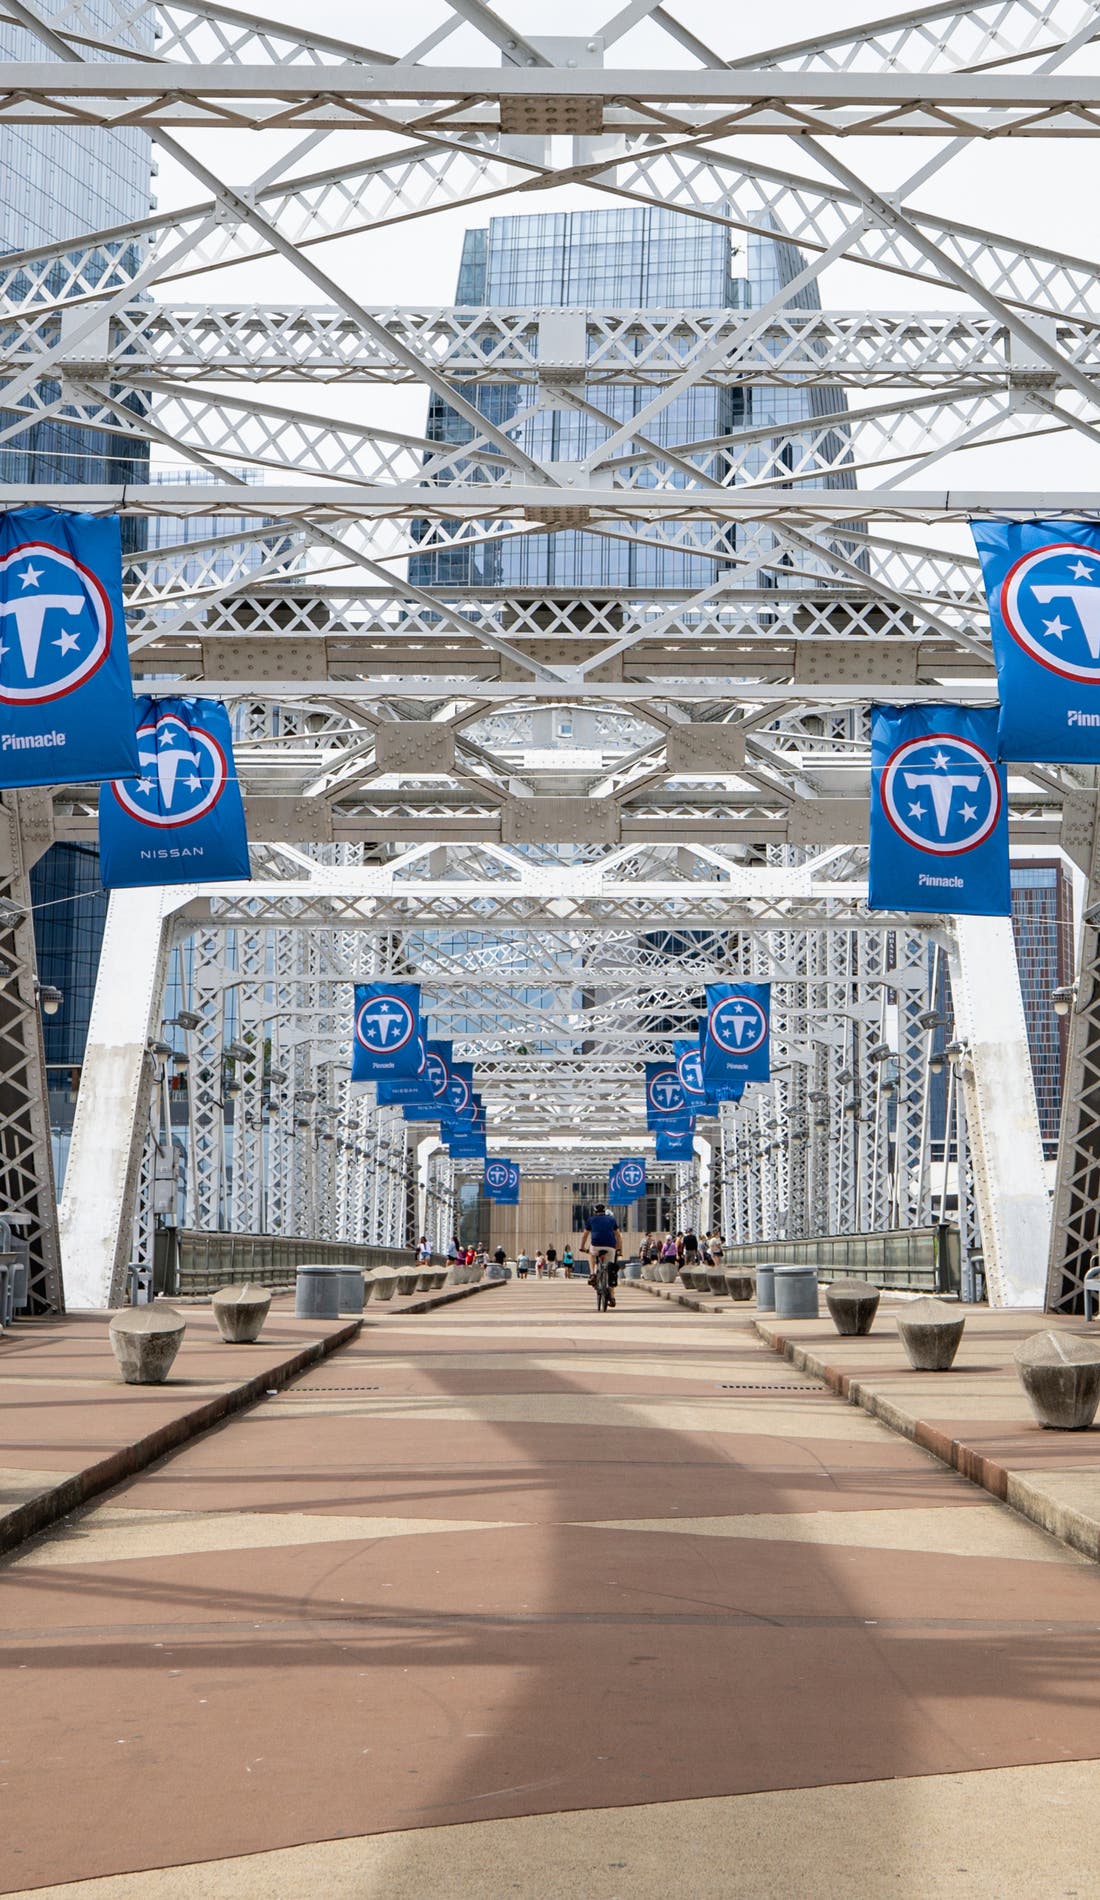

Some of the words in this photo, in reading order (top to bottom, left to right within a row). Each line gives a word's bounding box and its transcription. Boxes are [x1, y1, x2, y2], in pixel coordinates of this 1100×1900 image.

[1, 730, 66, 751] Pinnacle
[140, 847, 204, 859] NISSAN
[918, 873, 964, 888] Pinnacle
